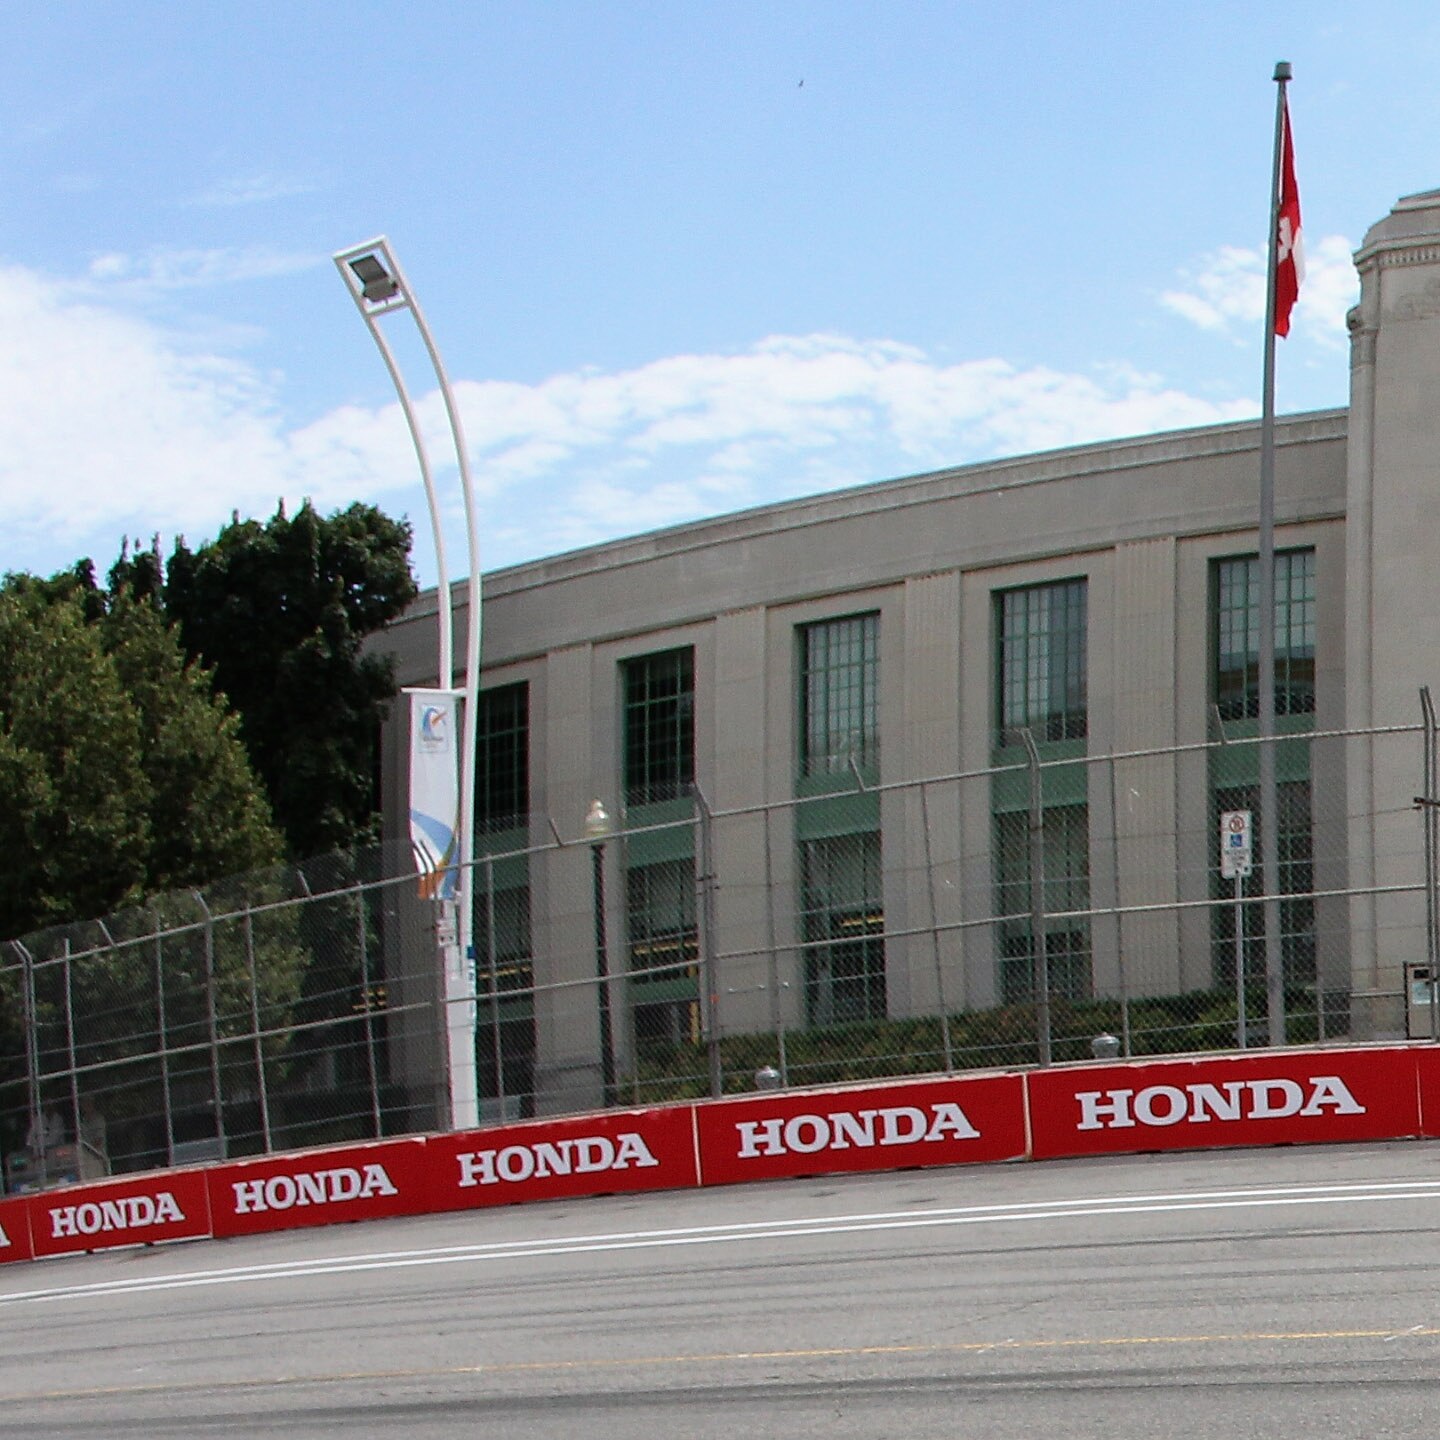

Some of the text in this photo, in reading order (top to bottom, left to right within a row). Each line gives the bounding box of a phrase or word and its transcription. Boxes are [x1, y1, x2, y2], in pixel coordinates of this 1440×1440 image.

[735, 1103, 980, 1159] HONDA
[1075, 1075, 1366, 1131] HONDA
[457, 1132, 658, 1189] HONDA
[50, 1191, 185, 1239] HONDA
[232, 1164, 398, 1215] HONDA
